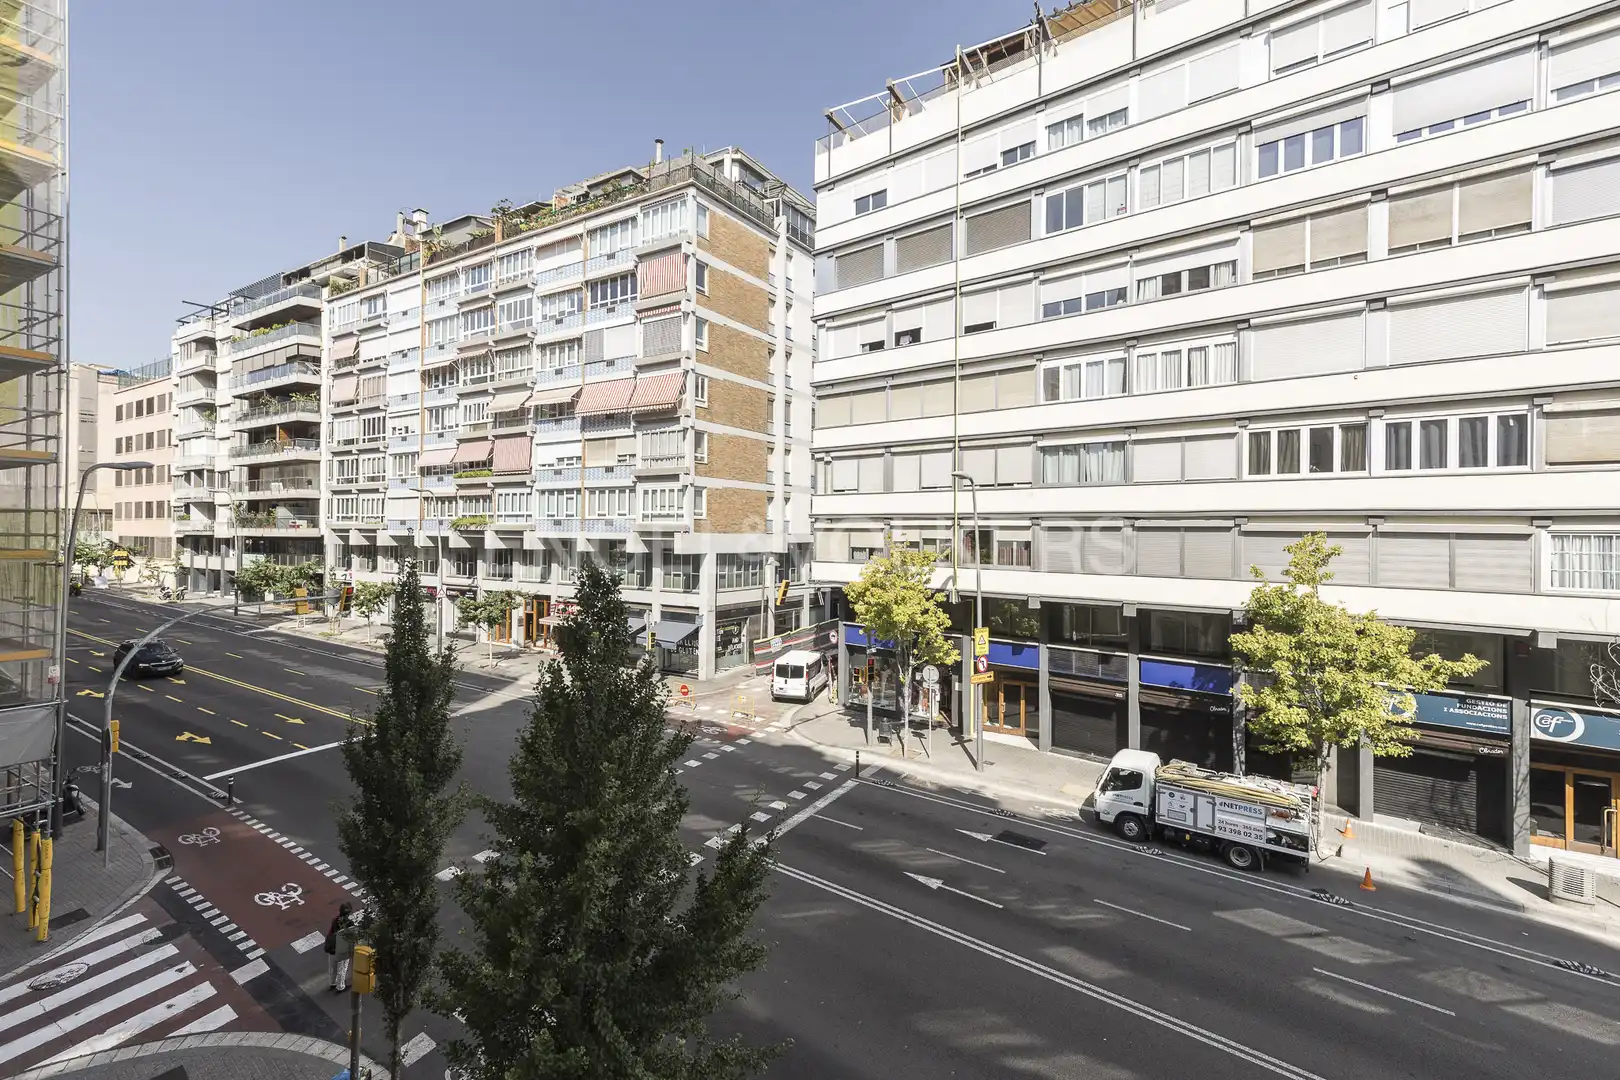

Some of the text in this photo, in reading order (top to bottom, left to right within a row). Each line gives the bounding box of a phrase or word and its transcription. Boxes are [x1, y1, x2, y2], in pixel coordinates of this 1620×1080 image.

[1449, 707, 1508, 720] ASSOCIACIONS
[1456, 702, 1508, 714] FUNDACIONS
[1223, 801, 1263, 815] NETPRESS
[1228, 827, 1242, 836] 398
[1243, 830, 1252, 838] 02
[1254, 833, 1264, 841] 35
